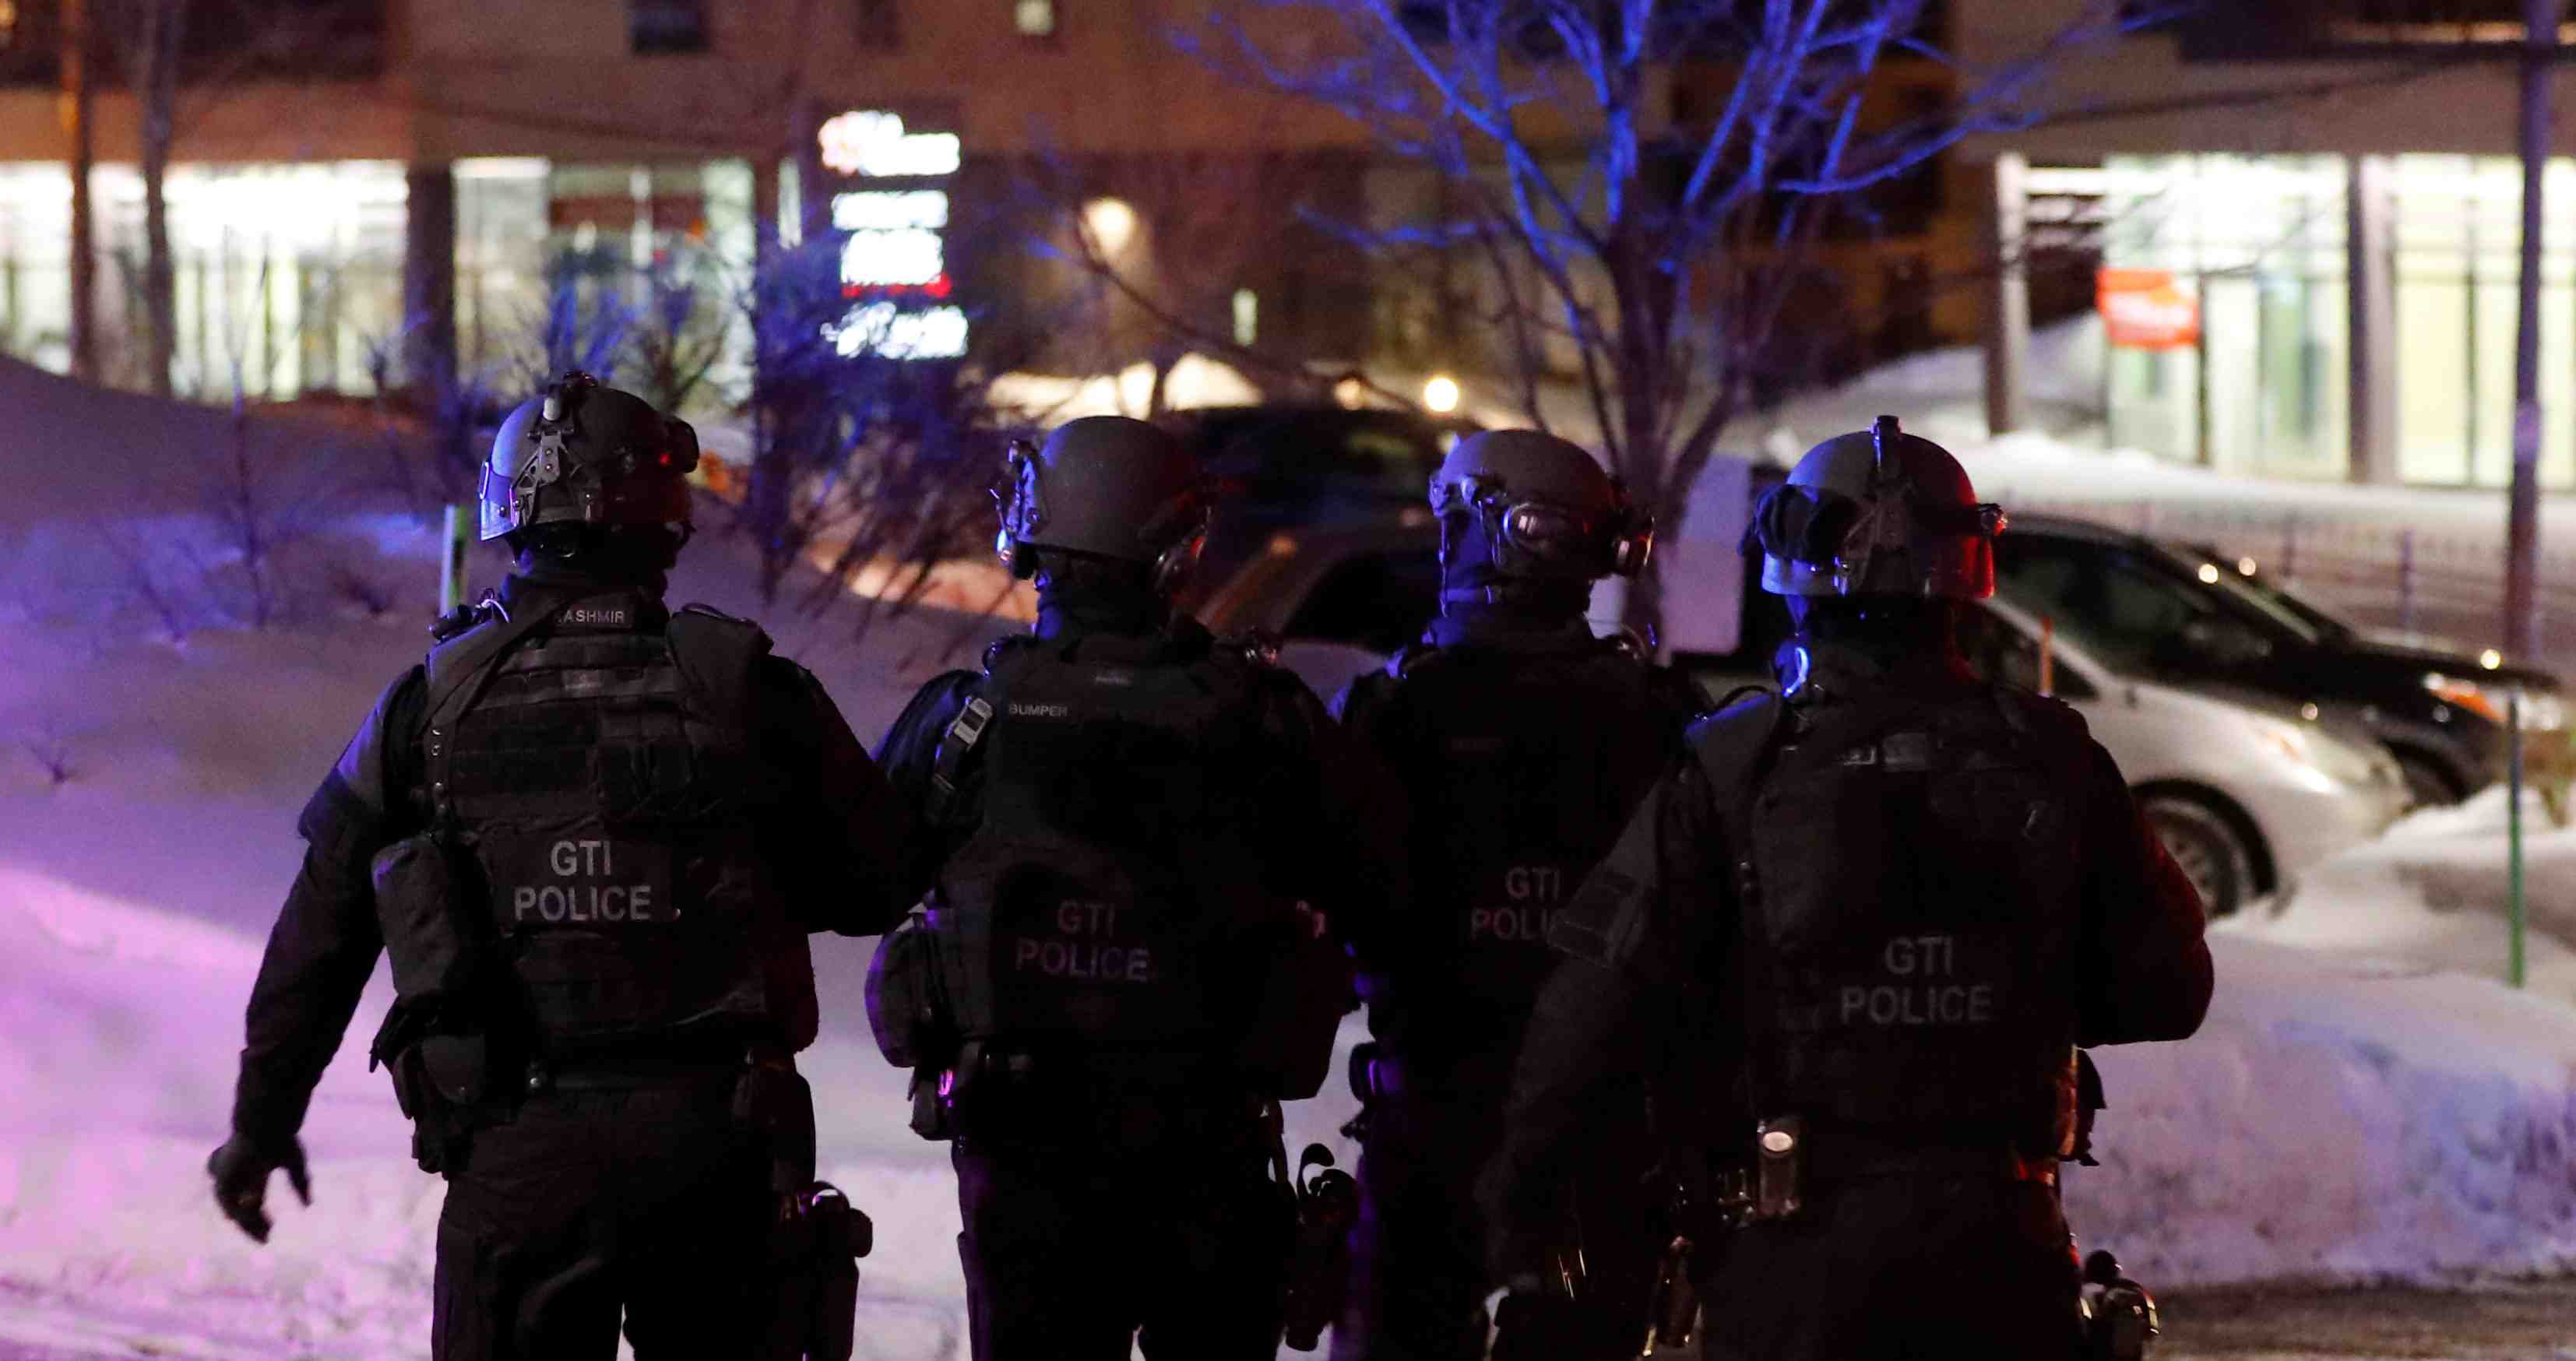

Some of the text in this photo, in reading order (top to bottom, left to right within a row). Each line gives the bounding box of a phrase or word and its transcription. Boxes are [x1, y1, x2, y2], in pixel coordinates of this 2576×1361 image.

[557, 610, 625, 624] ASHMIR
[1008, 704, 1068, 717] BUMPER
[550, 840, 611, 877] GTI
[1504, 865, 1561, 903] GTI
[514, 885, 652, 921] POLICE
[1057, 897, 1116, 939] GTI
[1470, 906, 1555, 941] POLI
[1015, 936, 1151, 983] POLICE
[1883, 935, 1955, 978] GTI
[1839, 984, 1993, 1025] POLICE
